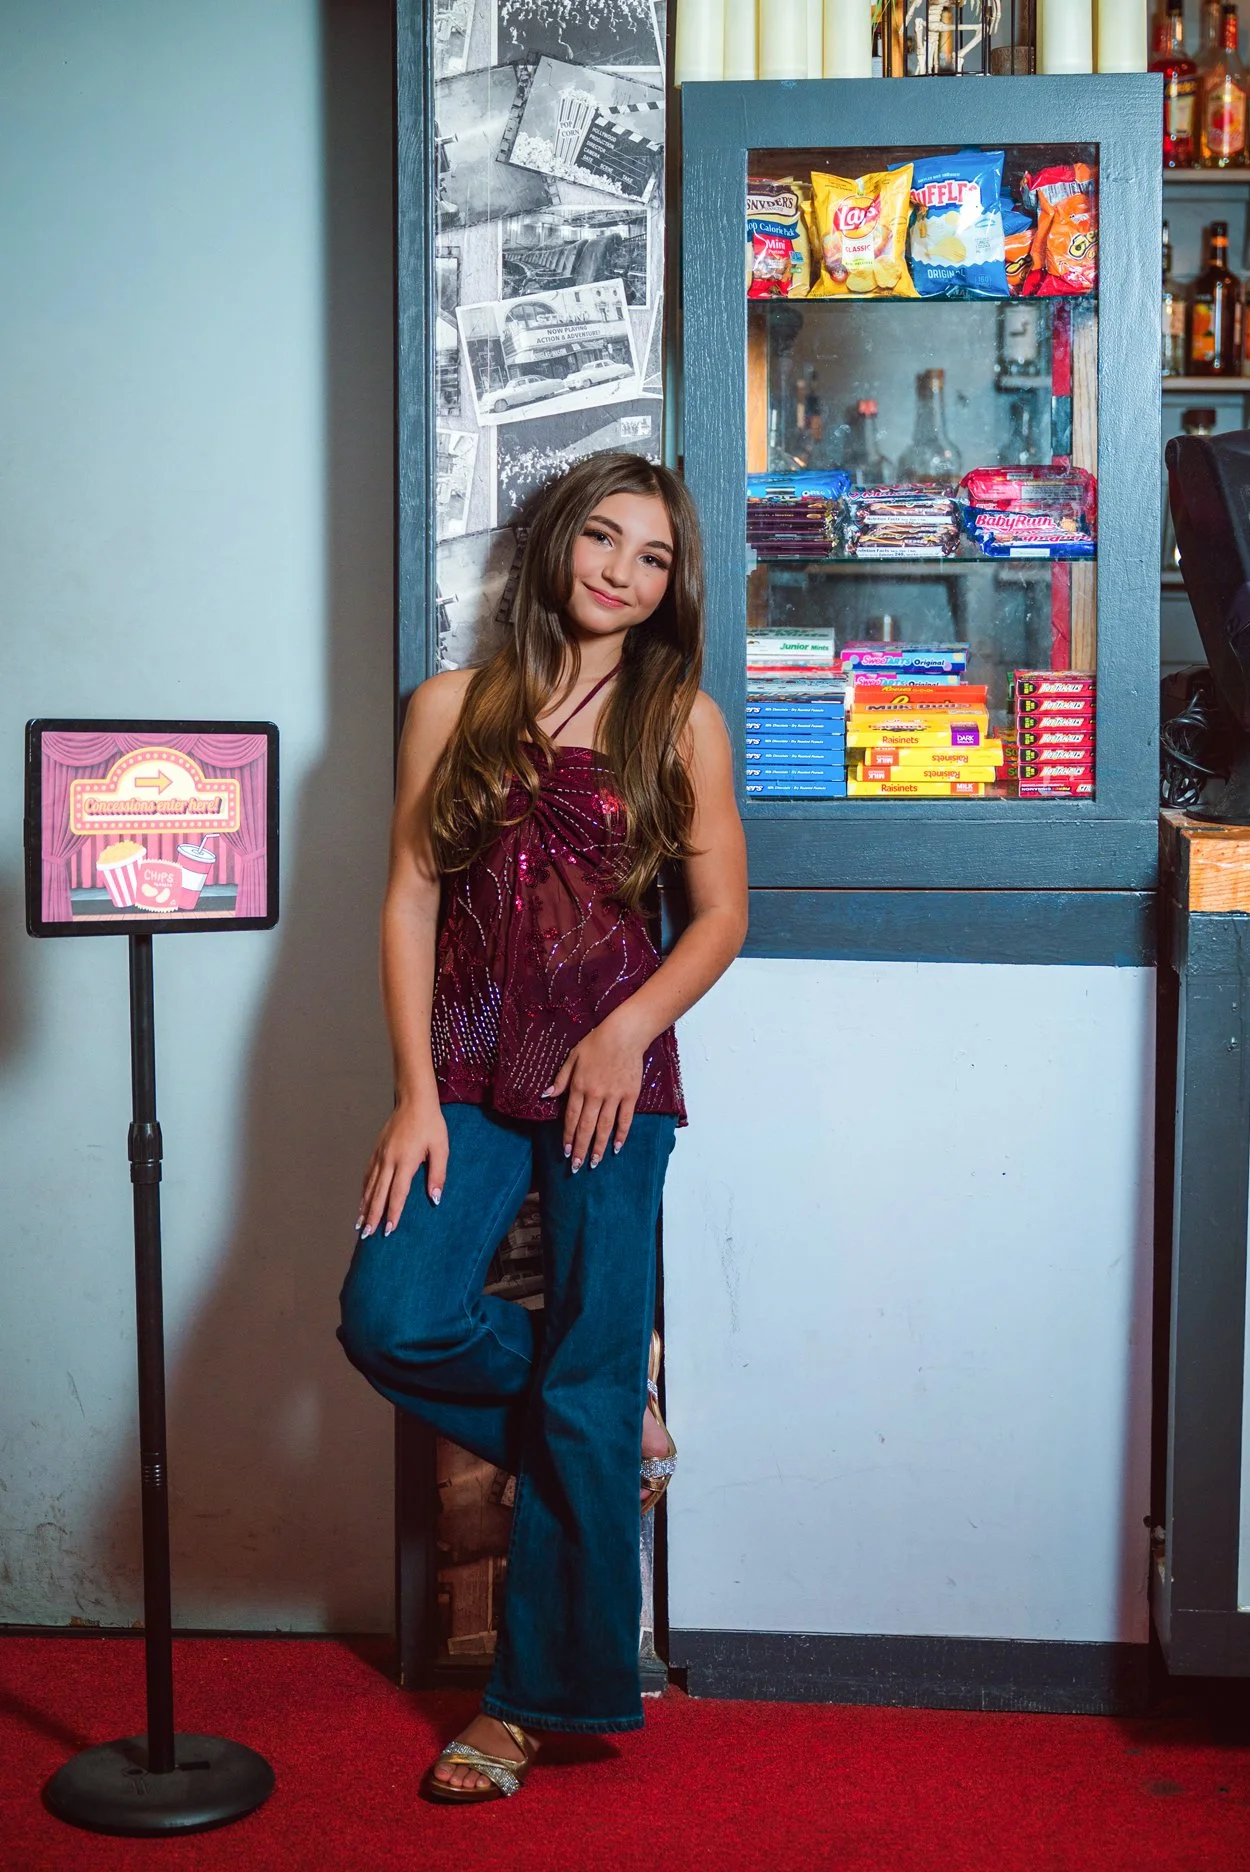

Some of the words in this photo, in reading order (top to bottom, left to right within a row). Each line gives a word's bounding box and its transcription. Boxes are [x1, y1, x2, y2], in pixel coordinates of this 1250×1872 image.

[560, 121, 573, 129] POP
[561, 128, 580, 138] CORN
[591, 127, 617, 143] HOLLYWOOD
[586, 140, 607, 154] DIRECTOR
[589, 134, 615, 150] PRODUCTION
[583, 147, 601, 159] CAMERA
[760, 223, 783, 235] Calorie
[766, 239, 786, 250] Mini
[845, 244, 871, 253] CLASSIC
[564, 325, 588, 334] PLAYING
[536, 335, 561, 344] ACTION
[780, 643, 809, 651] Junior
[914, 659, 945, 667] Original
[882, 735, 919, 744] Raisinets
[932, 754, 969, 763] Raisinets
[923, 769, 961, 779] Raisinets
[881, 783, 918, 792] Raisinets
[84, 796, 158, 816] Concessions
[157, 797, 189, 815] enter
[189, 796, 222, 815] here!
[144, 868, 174, 884] CHIPS
